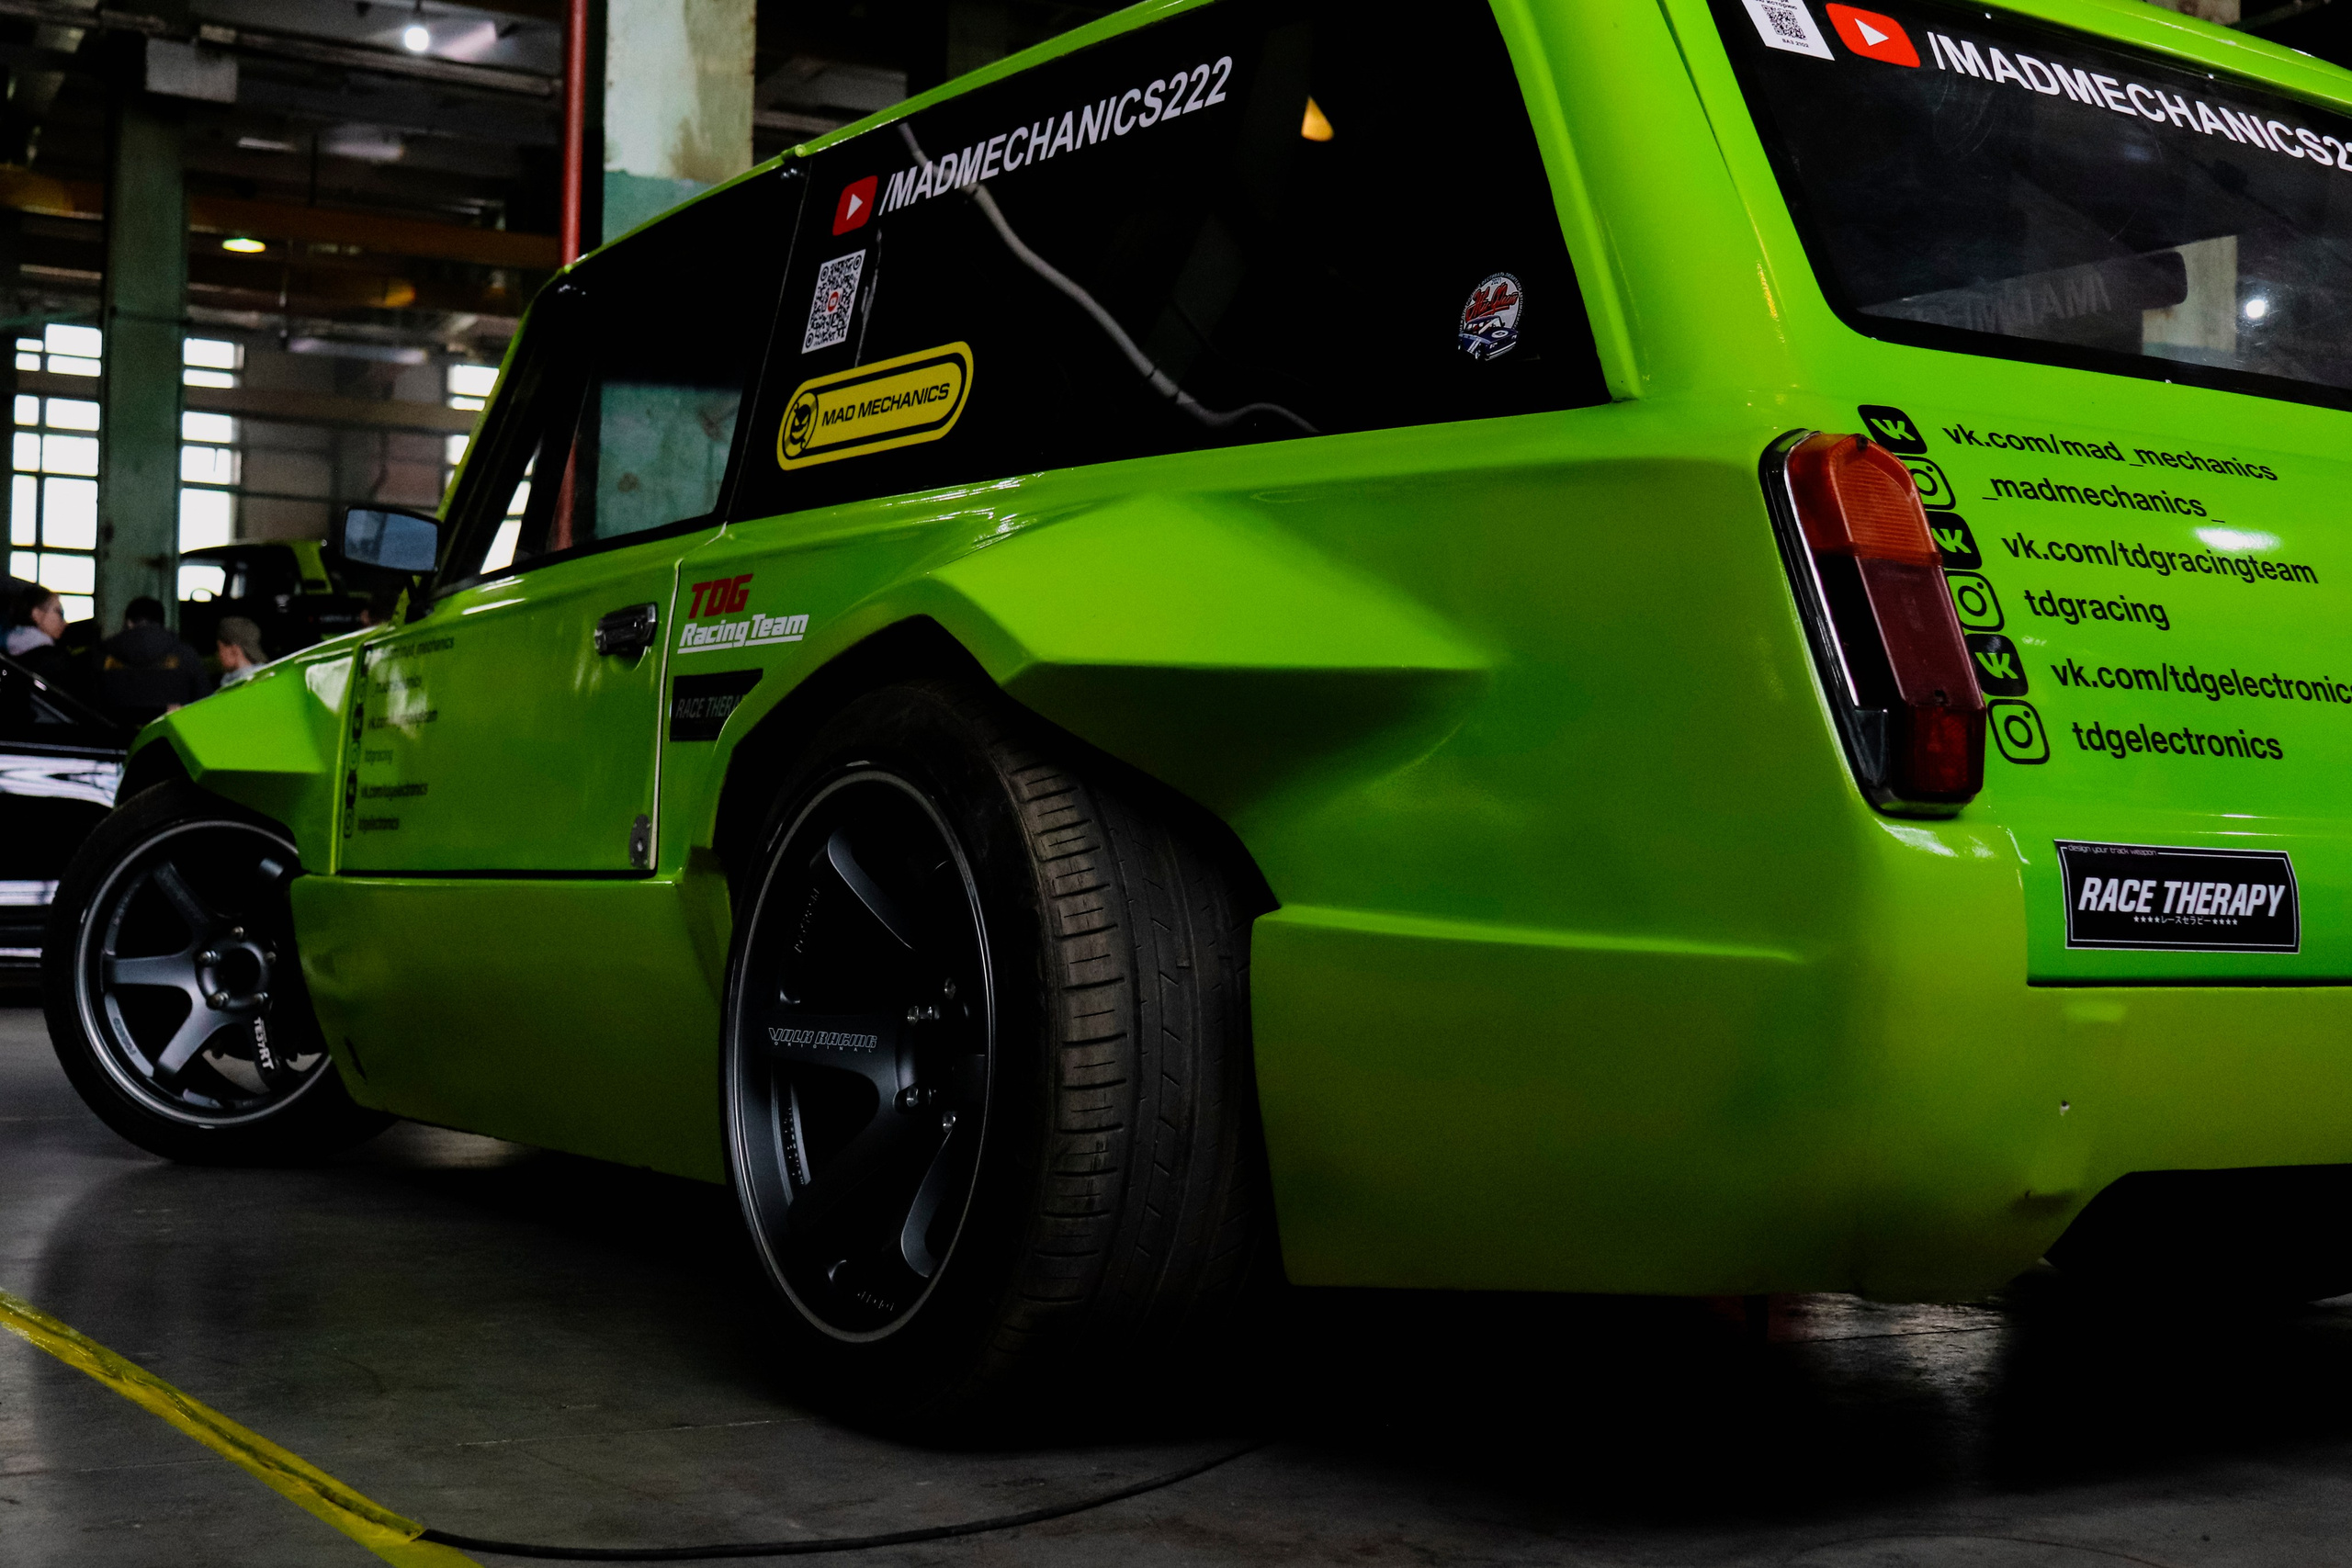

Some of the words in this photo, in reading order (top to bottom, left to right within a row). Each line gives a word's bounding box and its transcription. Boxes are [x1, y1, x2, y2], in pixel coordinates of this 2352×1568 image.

[1927, 30, 2352, 173] /MADMECHANICS2
[878, 55, 1233, 216] /MADMECHANICS222
[821, 404, 856, 427] MAD
[857, 382, 951, 419] MECHANICS
[2001, 532, 2319, 584] vk.com/tdgracingteam
[679, 619, 751, 647] Racing
[752, 613, 809, 638] Team
[2024, 590, 2170, 631] tdgracing
[2050, 658, 2352, 705] vk.com/tdgelectronic
[674, 696, 706, 718] RACE
[2072, 721, 2284, 761] tdgelectronics
[2077, 876, 2157, 913] RACE
[2163, 879, 2286, 918] THERAPY
[774, 1040, 873, 1054] ORIGINAL
